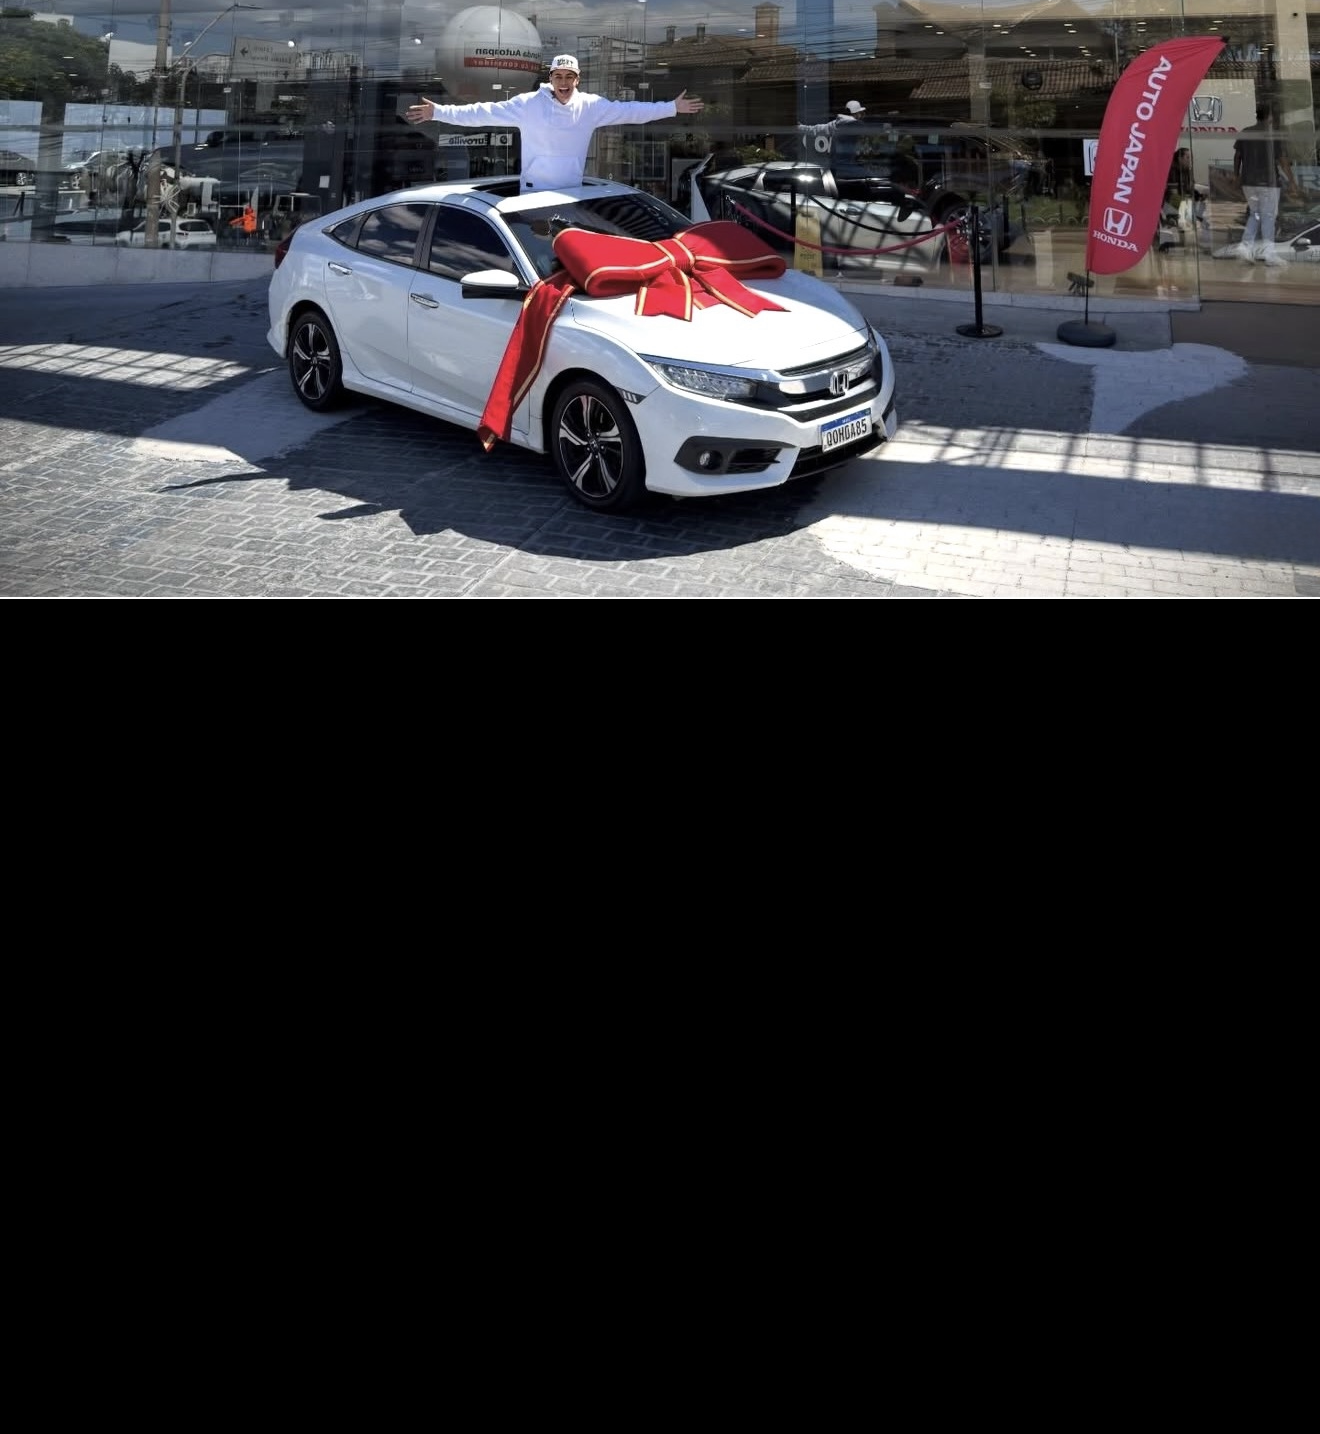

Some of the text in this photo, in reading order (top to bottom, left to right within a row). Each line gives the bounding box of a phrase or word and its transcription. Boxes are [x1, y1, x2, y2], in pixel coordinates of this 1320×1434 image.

[1113, 55, 1172, 204] AUTO JAPAN
[1093, 230, 1138, 253] HONDA
